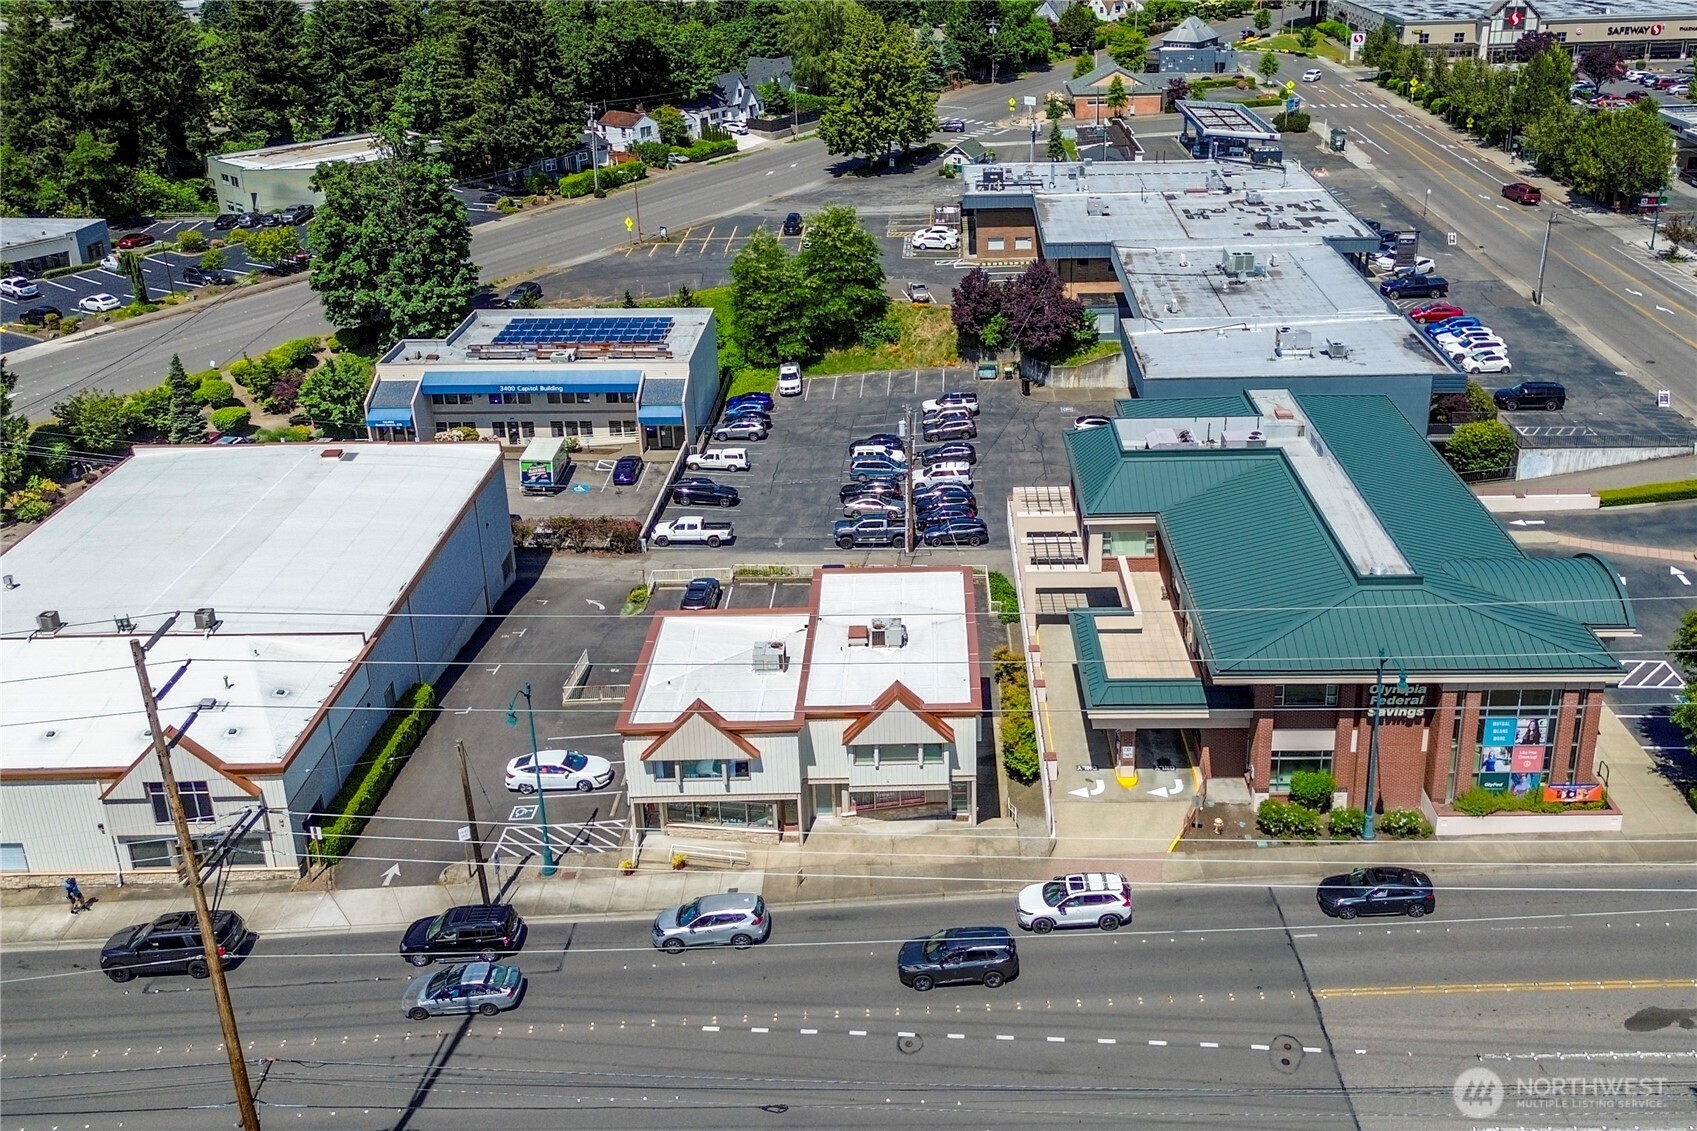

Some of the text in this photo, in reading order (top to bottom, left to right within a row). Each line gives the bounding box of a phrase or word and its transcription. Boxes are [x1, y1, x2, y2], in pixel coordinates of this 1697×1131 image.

[1607, 25, 1650, 36] SAFEWAY
[517, 385, 538, 393] Capitol
[540, 385, 564, 393] Building
[1370, 695, 1425, 705] Federal
[1367, 707, 1425, 719] Savings
